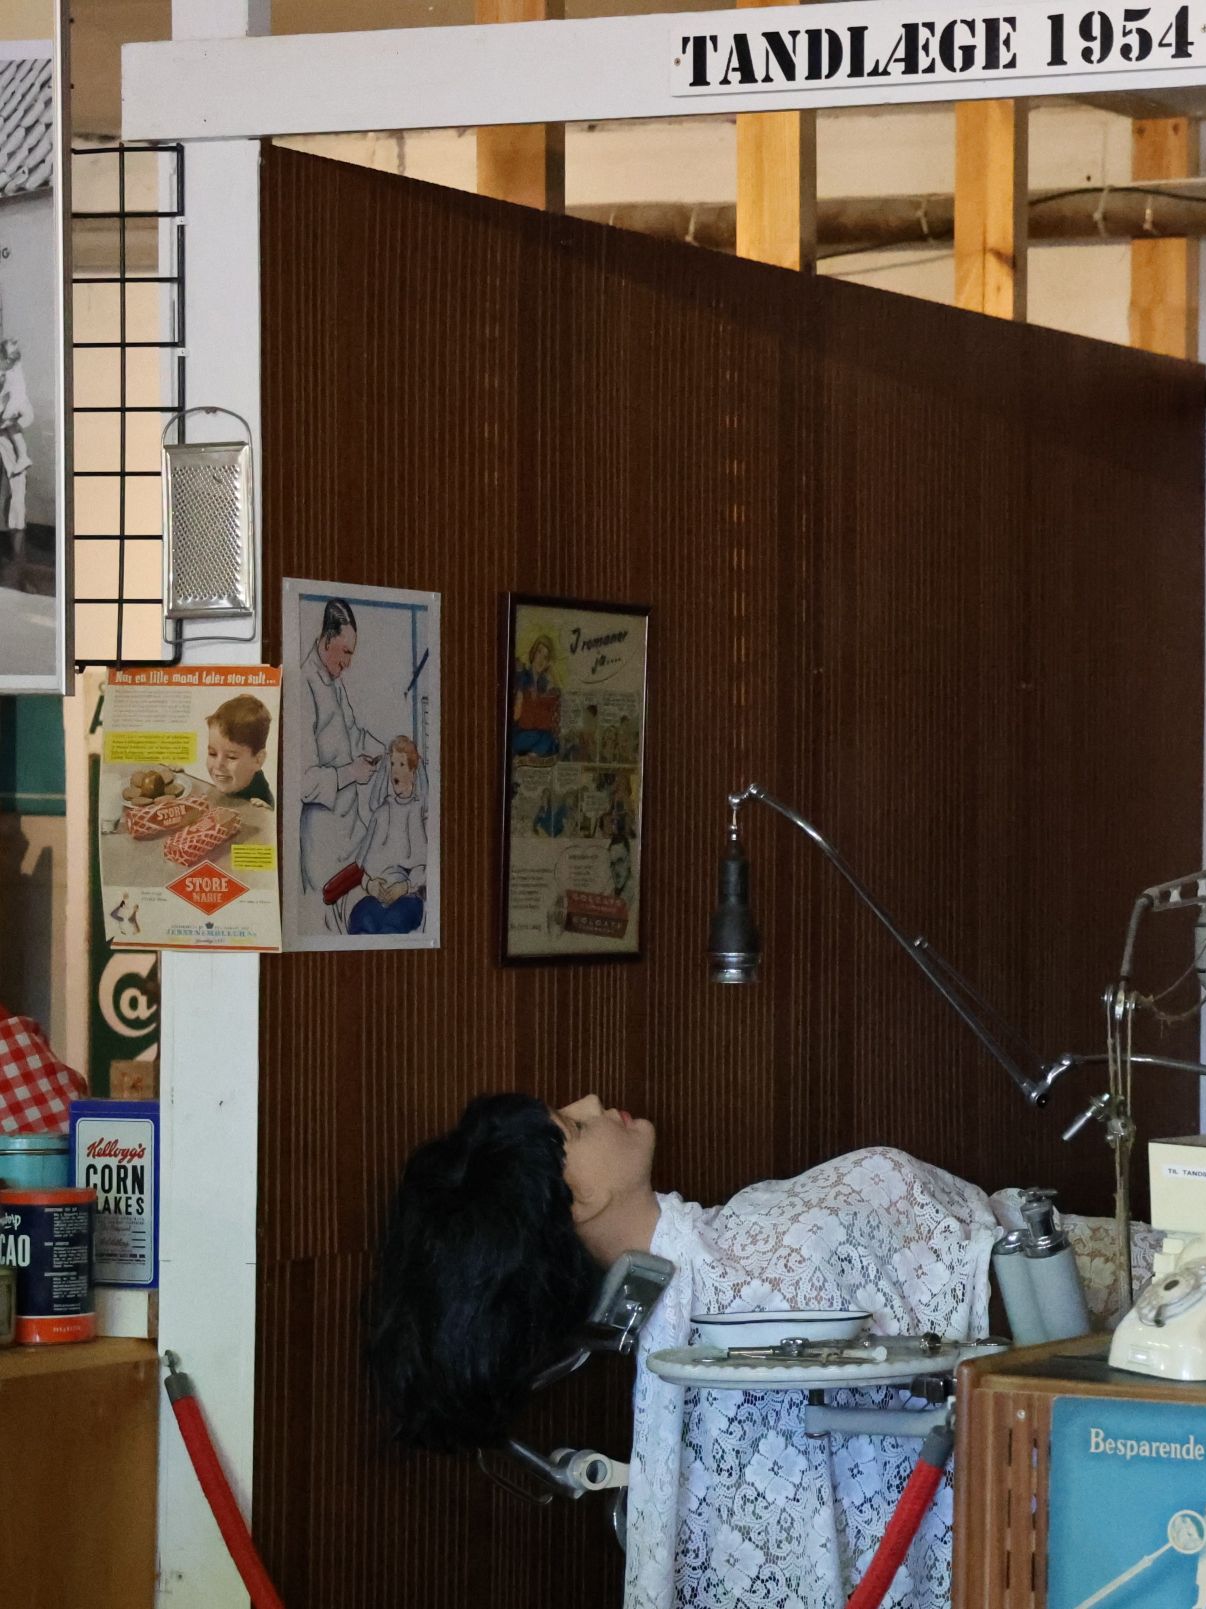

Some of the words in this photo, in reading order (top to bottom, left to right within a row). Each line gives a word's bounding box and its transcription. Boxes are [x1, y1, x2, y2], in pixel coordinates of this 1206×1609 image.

[681, 15, 1018, 87] TANDLÆGE
[1046, 5, 1195, 67] 1954
[581, 630, 629, 651] romaner
[150, 670, 169, 684] lille
[172, 671, 199, 684] mand
[185, 877, 229, 892] STORE
[86, 1136, 147, 1164] Kellogg's
[85, 1163, 145, 1195] CORN
[94, 1195, 145, 1216] LAKES
[1089, 1427, 1206, 1461] Besparende
